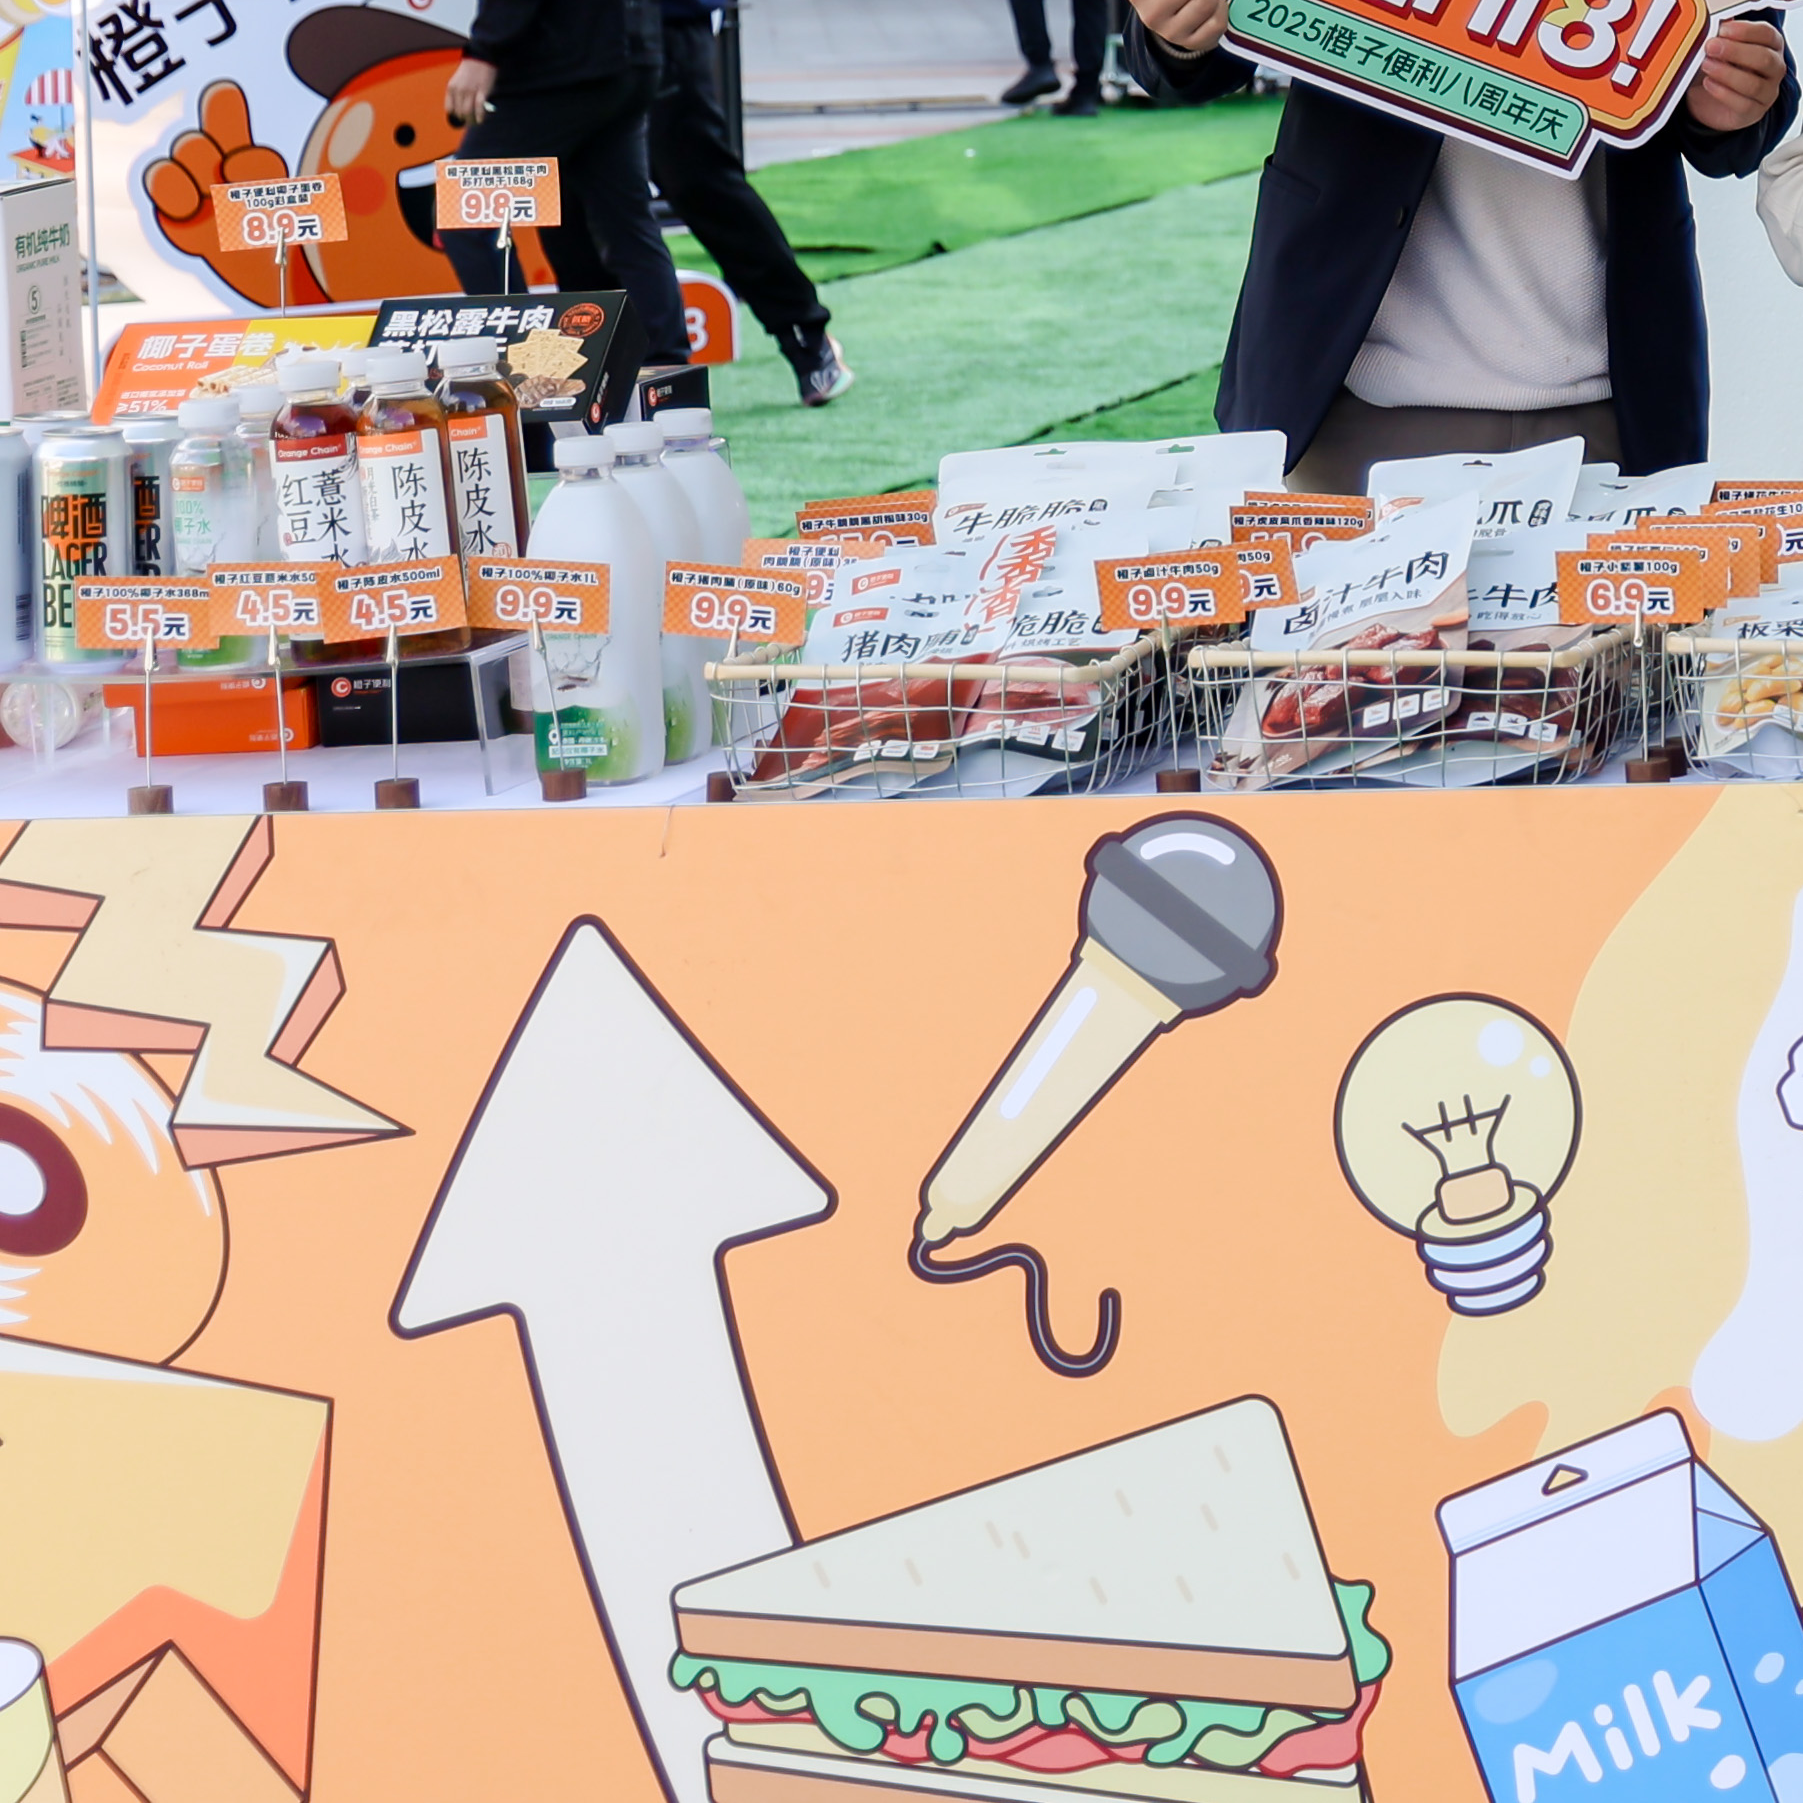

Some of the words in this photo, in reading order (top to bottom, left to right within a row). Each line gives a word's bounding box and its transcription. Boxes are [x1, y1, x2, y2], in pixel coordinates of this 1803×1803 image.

[15, 223, 71, 260] 有机纯牛奶
[381, 305, 555, 338] 黑松露牛肉
[137, 333, 276, 359] 椰子蛋卷
[132, 363, 184, 373] Coconut
[187, 360, 209, 371] Roll
[41, 493, 107, 539] 啤酒
[281, 473, 317, 545] 红豆
[456, 447, 502, 554] 陈皮水
[41, 542, 107, 580] LAGER
[236, 590, 319, 626] 4.5元
[351, 591, 436, 630] 4.5元
[496, 585, 582, 626] 9.9元
[691, 591, 776, 634] 9.9元
[1129, 583, 1214, 620] 9.9元
[1586, 579, 1676, 615] 6.9元
[106, 604, 190, 641] 5.5元
[1512, 1669, 1723, 1803] Milk
